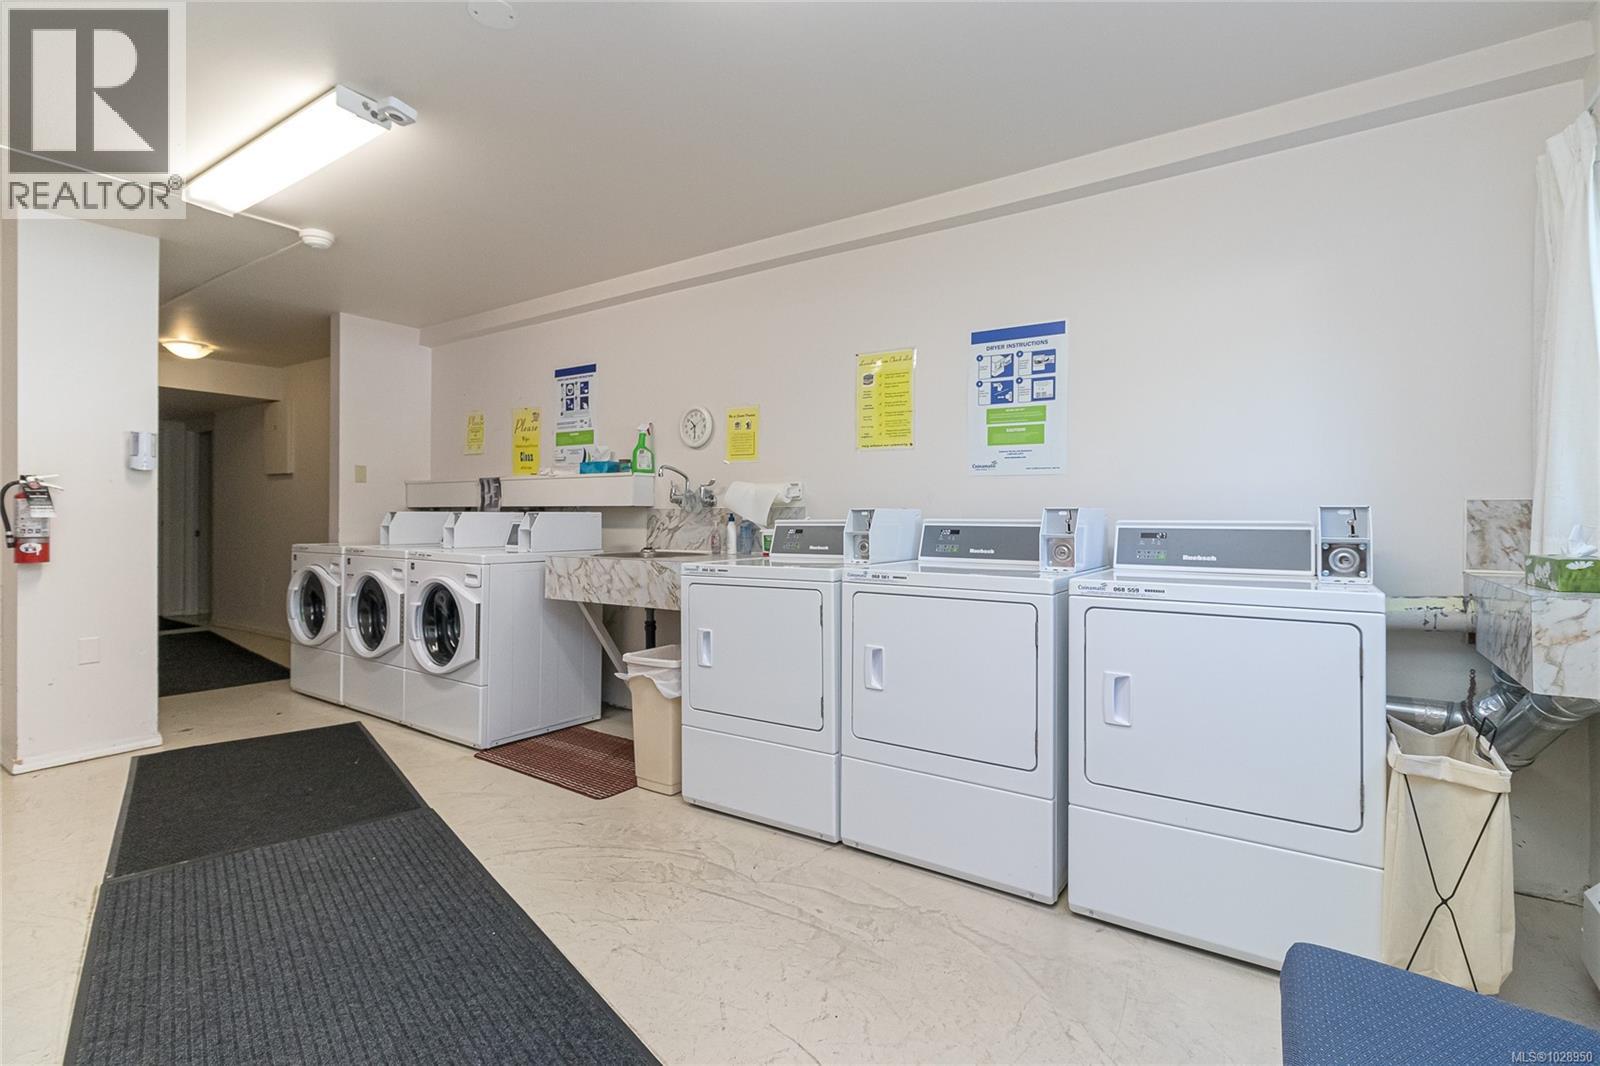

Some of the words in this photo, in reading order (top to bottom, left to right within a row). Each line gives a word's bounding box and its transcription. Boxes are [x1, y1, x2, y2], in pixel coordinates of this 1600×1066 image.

[986, 344, 1005, 352] DRYER
[1006, 339, 1049, 350] INSTRUCTIONS
[514, 417, 538, 434] Please
